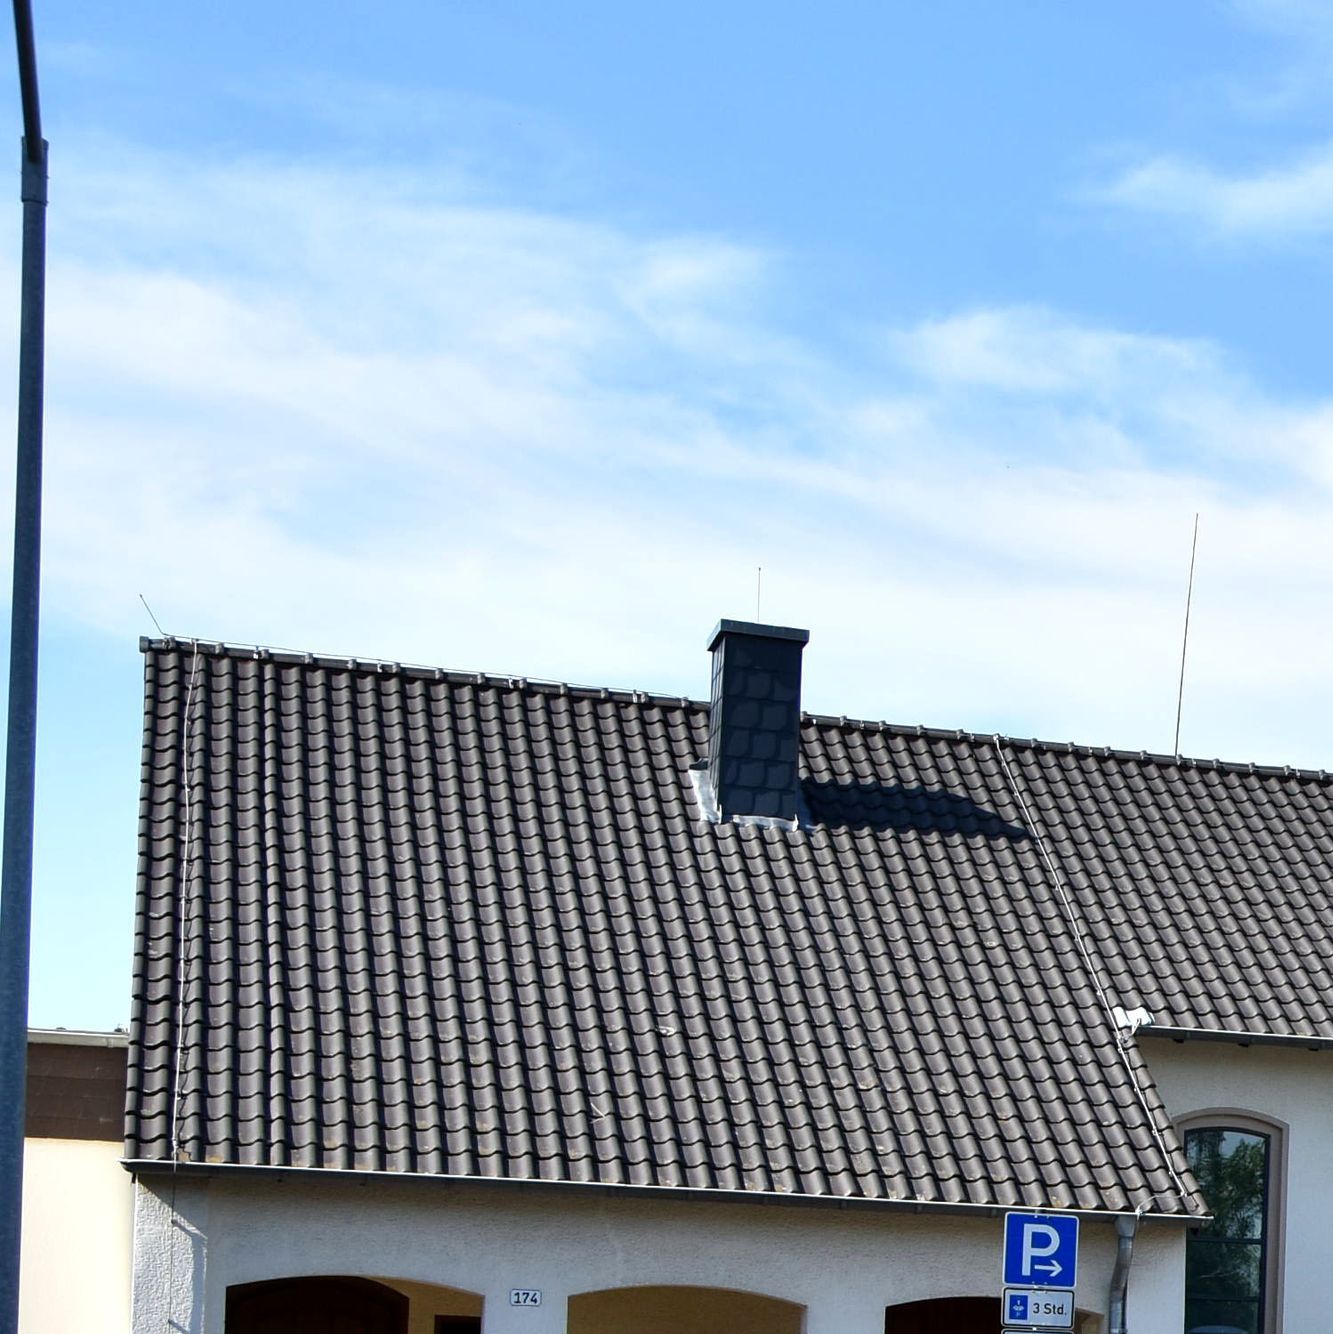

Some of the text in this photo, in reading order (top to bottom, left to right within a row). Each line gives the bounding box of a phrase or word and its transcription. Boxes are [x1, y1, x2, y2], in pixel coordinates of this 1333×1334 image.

[1021, 1223, 1061, 1277] P
[513, 1292, 538, 1304] 174
[1032, 1302, 1067, 1316] 3 Std.
